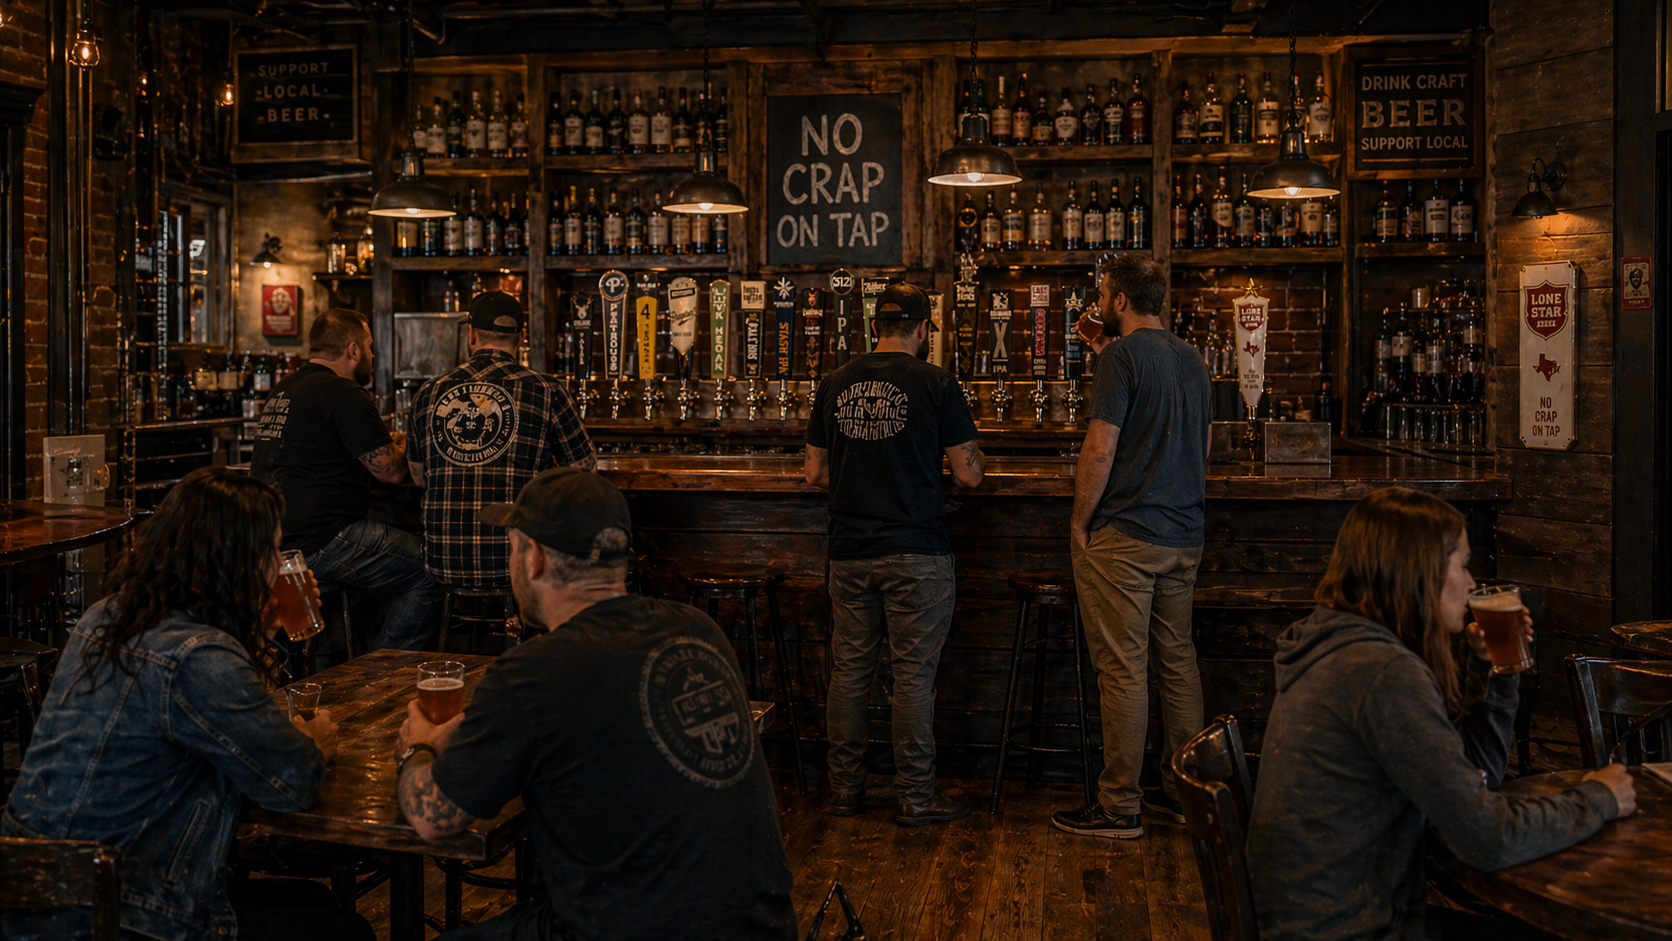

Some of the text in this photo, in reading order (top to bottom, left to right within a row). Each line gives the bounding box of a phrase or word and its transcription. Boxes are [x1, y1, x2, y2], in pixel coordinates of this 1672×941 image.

[258, 62, 329, 77] SUPPORT
[1361, 73, 1468, 91] DRINK CRAFT
[263, 84, 321, 99] LOCAL
[267, 107, 319, 122] BEER
[1361, 98, 1467, 128] BEER
[801, 113, 863, 156] NO
[1361, 135, 1468, 151] SUPPORT LOCAL
[782, 162, 885, 205] CRAP
[776, 211, 890, 248] ON TAP
[1531, 293, 1562, 305] LONE
[640, 303, 651, 320] 4
[1531, 306, 1562, 318] STAR
[993, 365, 1007, 374] IPA
[1540, 397, 1552, 409] NO
[1534, 411, 1558, 423] CRAP
[1532, 425, 1560, 437] ON TAP
